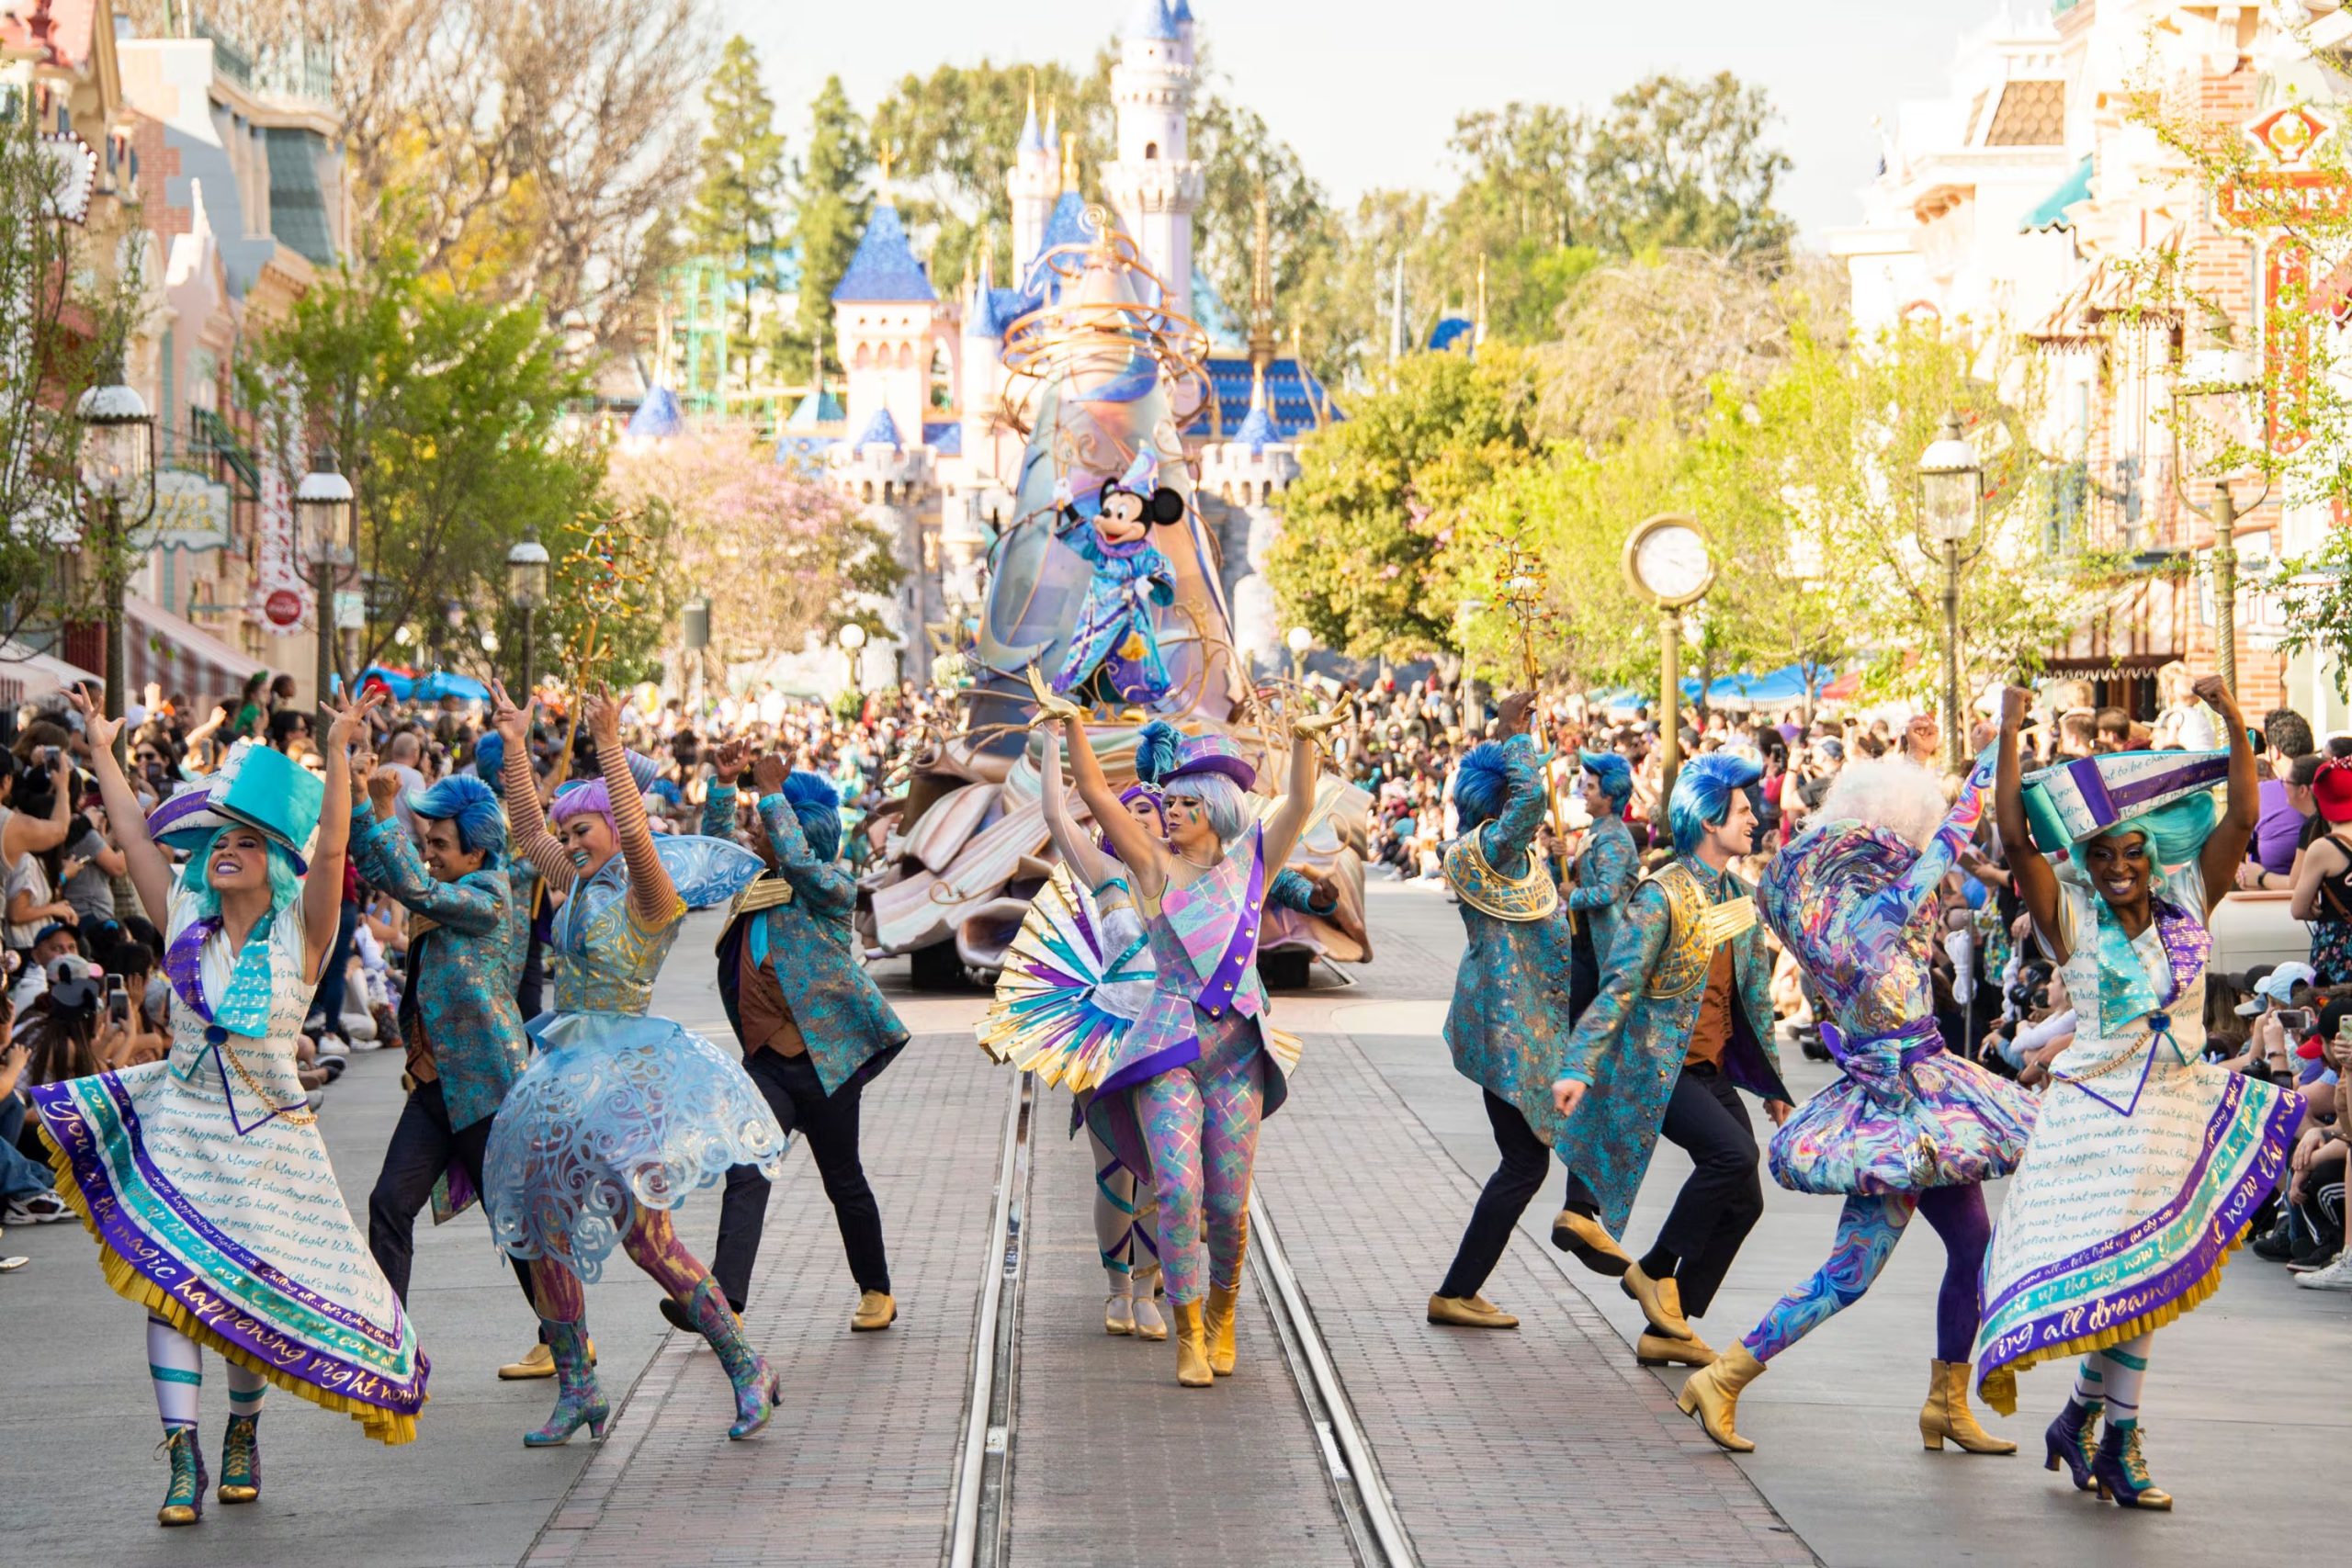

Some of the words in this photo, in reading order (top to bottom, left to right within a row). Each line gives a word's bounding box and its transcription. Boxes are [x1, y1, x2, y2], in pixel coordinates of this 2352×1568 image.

[2126, 1122, 2139, 1135] to
[183, 1147, 220, 1164] when)
[241, 1134, 276, 1150] That's
[276, 1144, 301, 1156] when
[221, 1153, 264, 1168] Magic
[2051, 1149, 2110, 1170] Happens!
[2109, 1165, 2146, 1179] Magic
[182, 1168, 214, 1185] spells
[215, 1173, 245, 1187] break
[261, 1181, 307, 1201] shooting
[307, 1194, 332, 1207] star
[332, 1198, 344, 1209] to
[234, 1195, 252, 1209] So
[254, 1199, 278, 1214] hold
[2106, 1205, 2123, 1217] the
[42, 1095, 90, 1154] You
[93, 1193, 119, 1225] the
[112, 1224, 177, 1280] magic
[173, 1275, 309, 1365] happening
[310, 1353, 374, 1399] right
[171, 1193, 216, 1236] happening
[212, 1234, 241, 1255] right
[238, 1252, 262, 1271] now
[260, 1265, 300, 1294] Calling
[2042, 1305, 2085, 1341] all
[2087, 1261, 2192, 1332] dreamers
[2223, 1174, 2259, 1225] now
[2259, 1139, 2285, 1181] the
[2091, 1239, 2114, 1258] light
[252, 1244, 281, 1258] make
[281, 1251, 311, 1265] come
[2064, 1276, 2087, 1296] the
[2091, 1262, 2118, 1285] sky
[2123, 1245, 2154, 1270] now
[163, 1220, 189, 1242] the
[337, 1334, 380, 1358] come
[323, 1278, 360, 1297] when)
